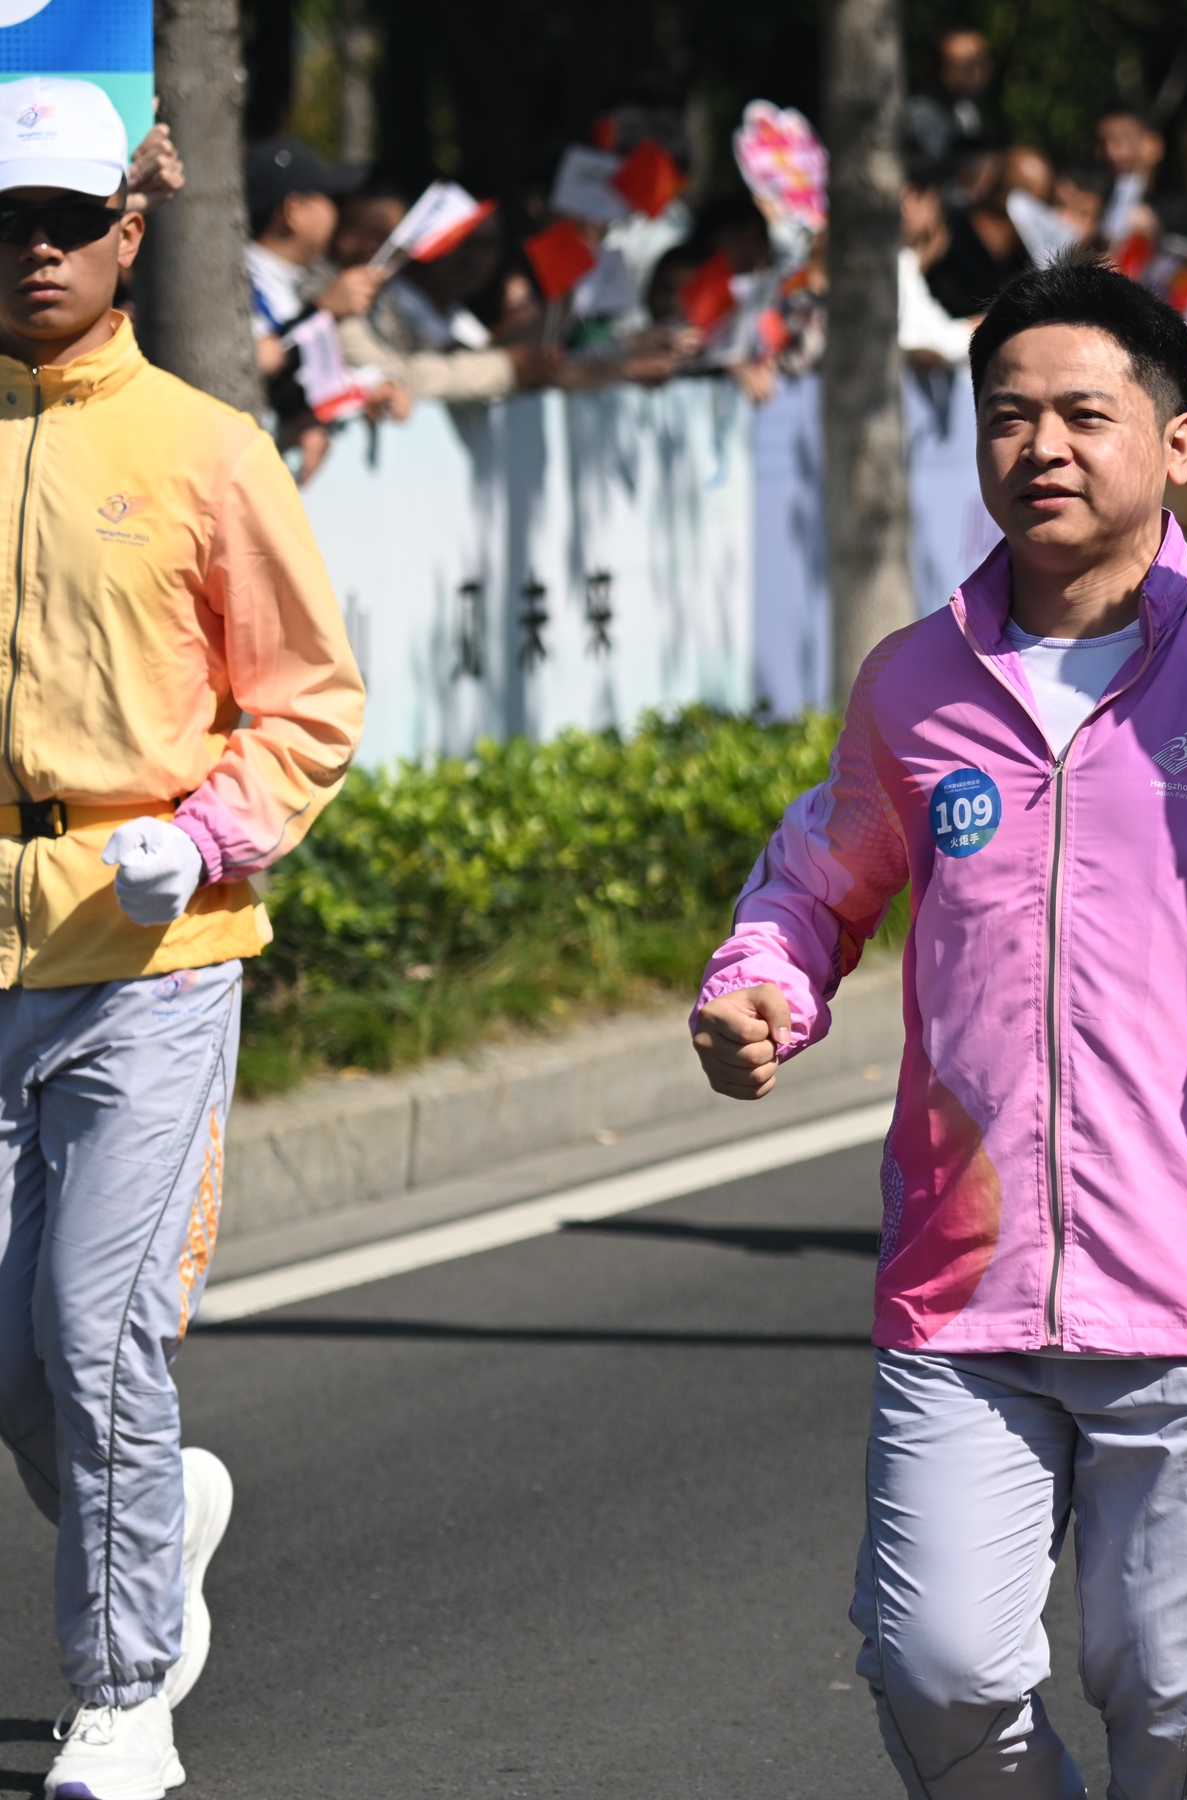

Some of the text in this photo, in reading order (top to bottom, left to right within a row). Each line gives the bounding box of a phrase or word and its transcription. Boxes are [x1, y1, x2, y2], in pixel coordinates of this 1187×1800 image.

[1155, 789, 1174, 797] Asian
[935, 793, 993, 835] 109
[950, 832, 980, 849] 火炬手
